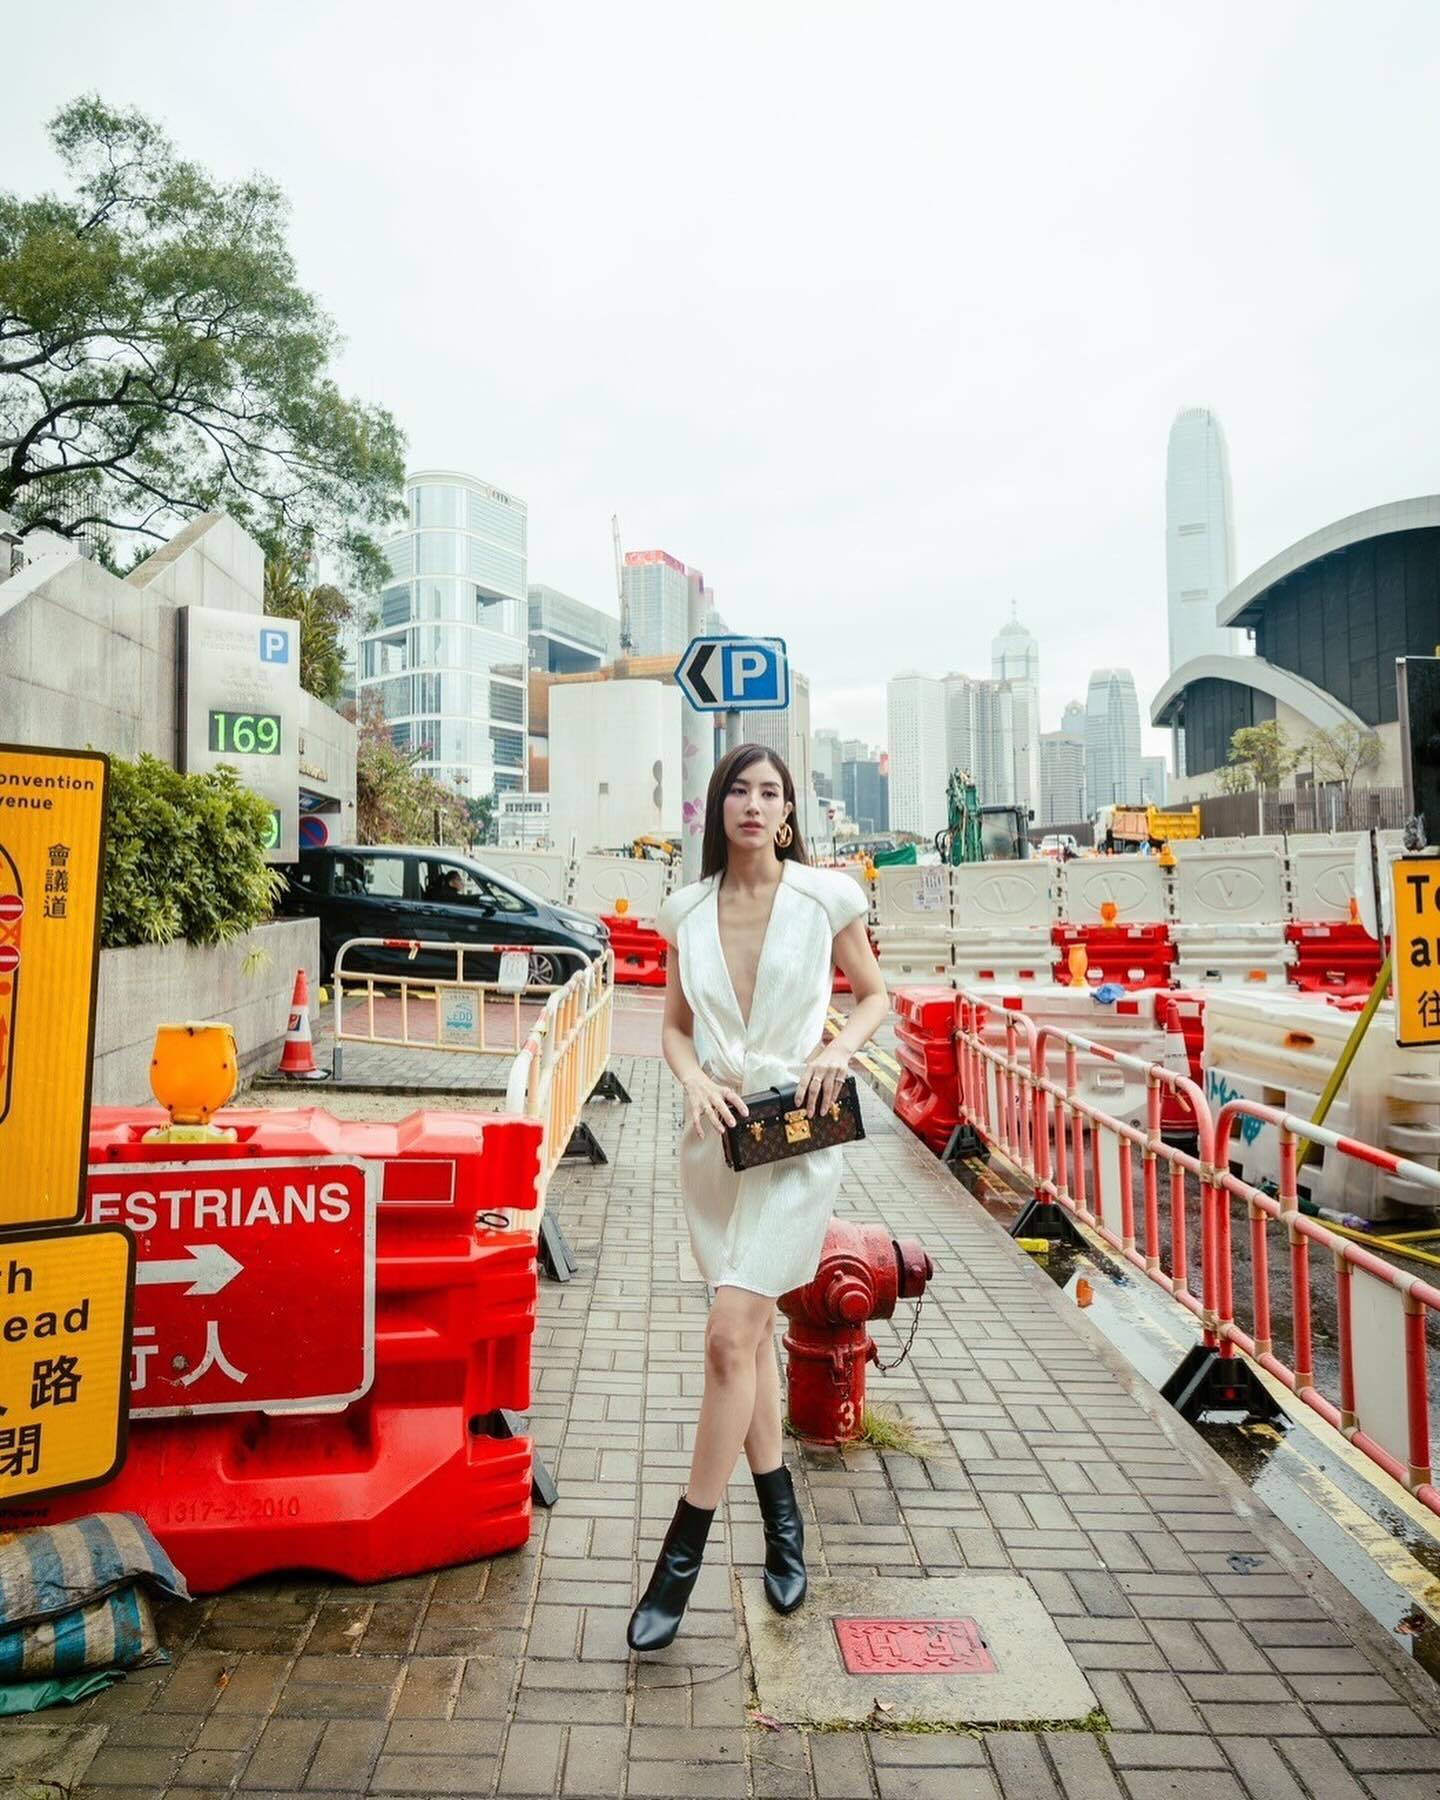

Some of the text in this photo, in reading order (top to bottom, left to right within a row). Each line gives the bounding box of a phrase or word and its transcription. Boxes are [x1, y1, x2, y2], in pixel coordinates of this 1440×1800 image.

[265, 633, 284, 660] P
[731, 651, 767, 696] P
[214, 714, 279, 754] 169
[43, 843, 71, 919] 會議道
[1406, 875, 1440, 915] T
[1410, 936, 1440, 968] a
[80, 1182, 350, 1232] ESTRIANS
